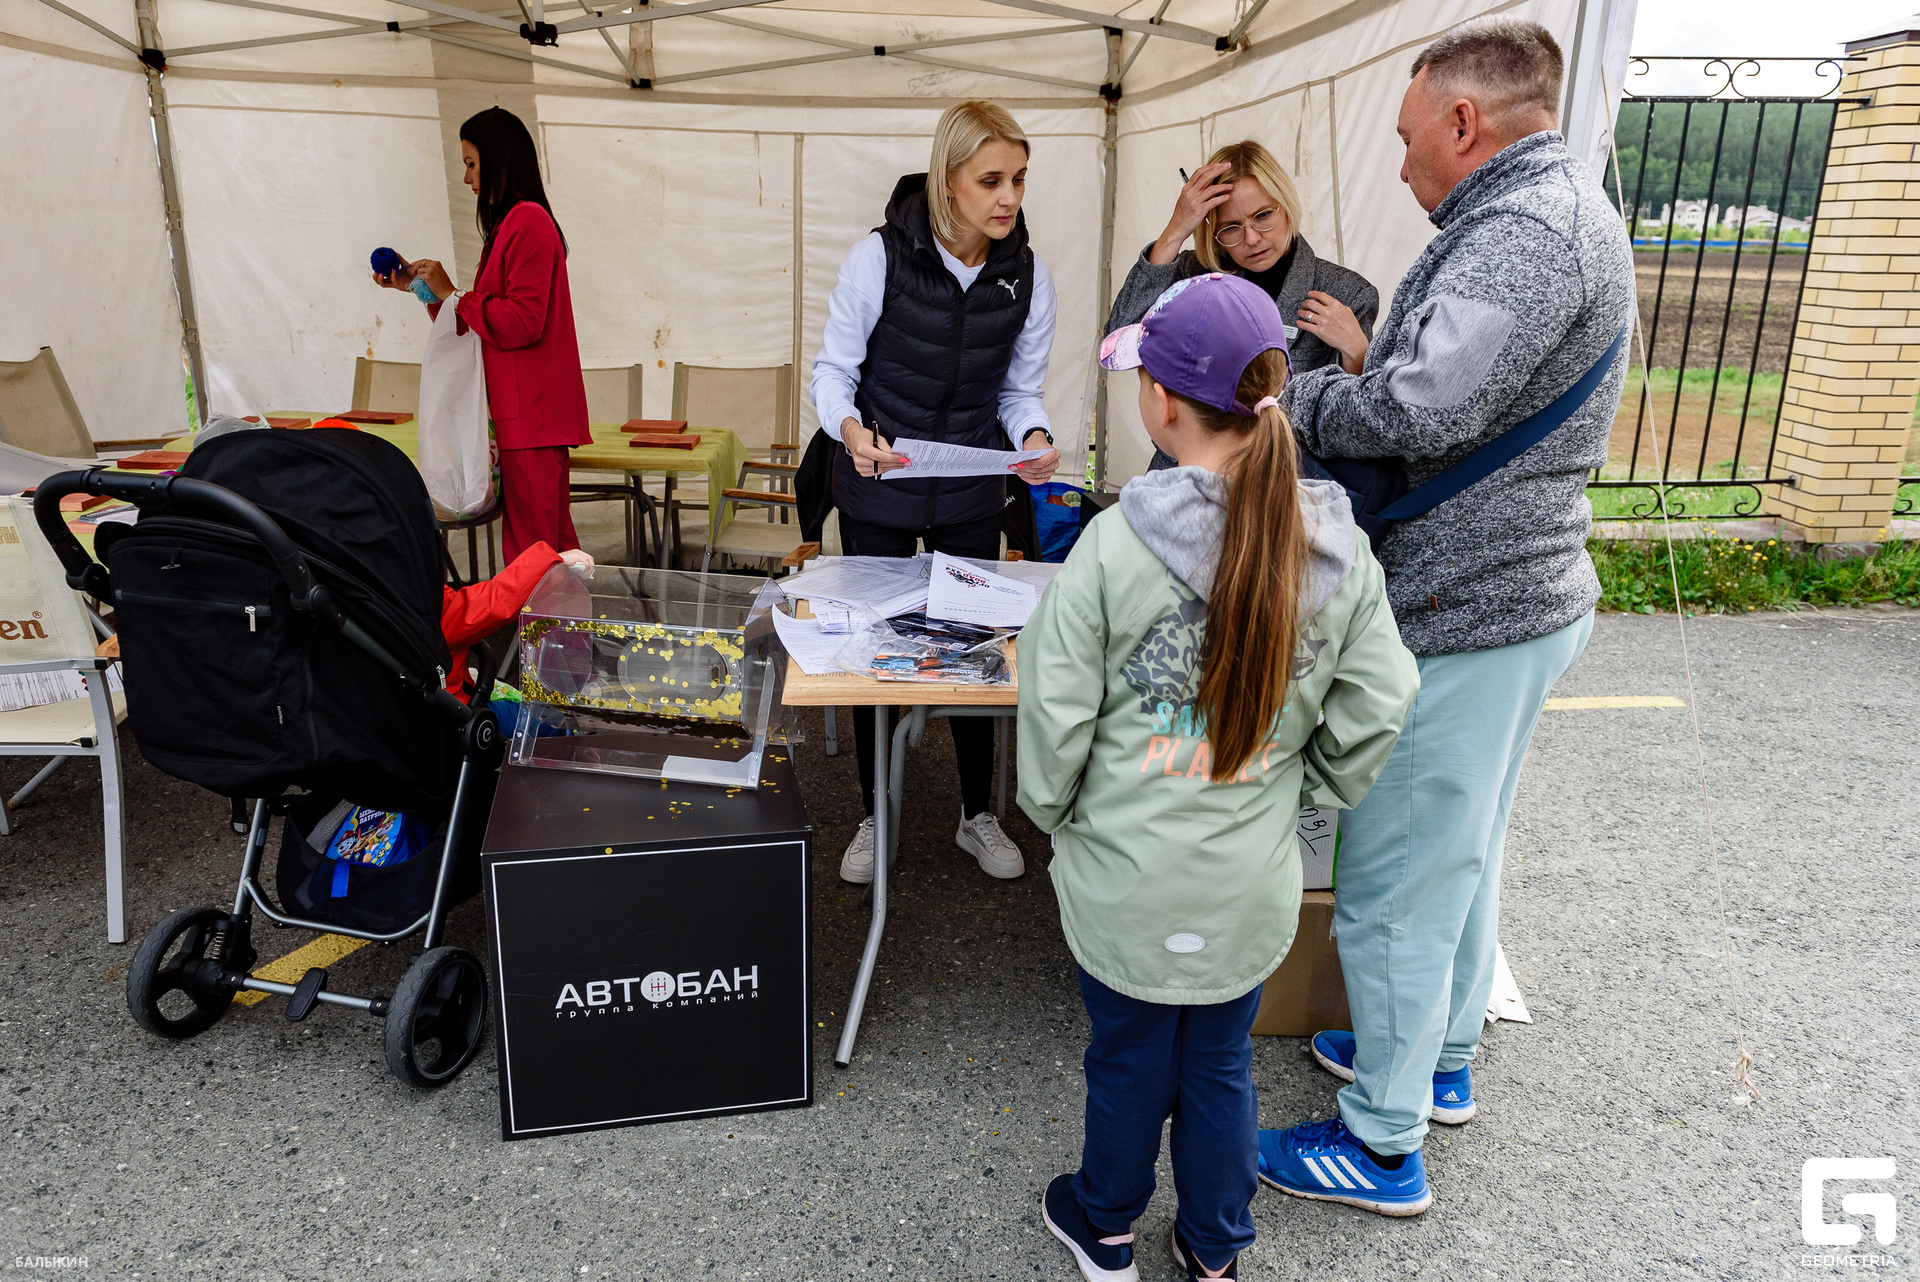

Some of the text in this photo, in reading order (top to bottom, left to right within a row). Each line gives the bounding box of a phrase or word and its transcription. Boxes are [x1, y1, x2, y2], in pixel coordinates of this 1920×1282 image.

[1140, 736, 1279, 785] PLAET
[555, 965, 759, 1010] АВТОБАН
[556, 991, 758, 1019] группа компаний
